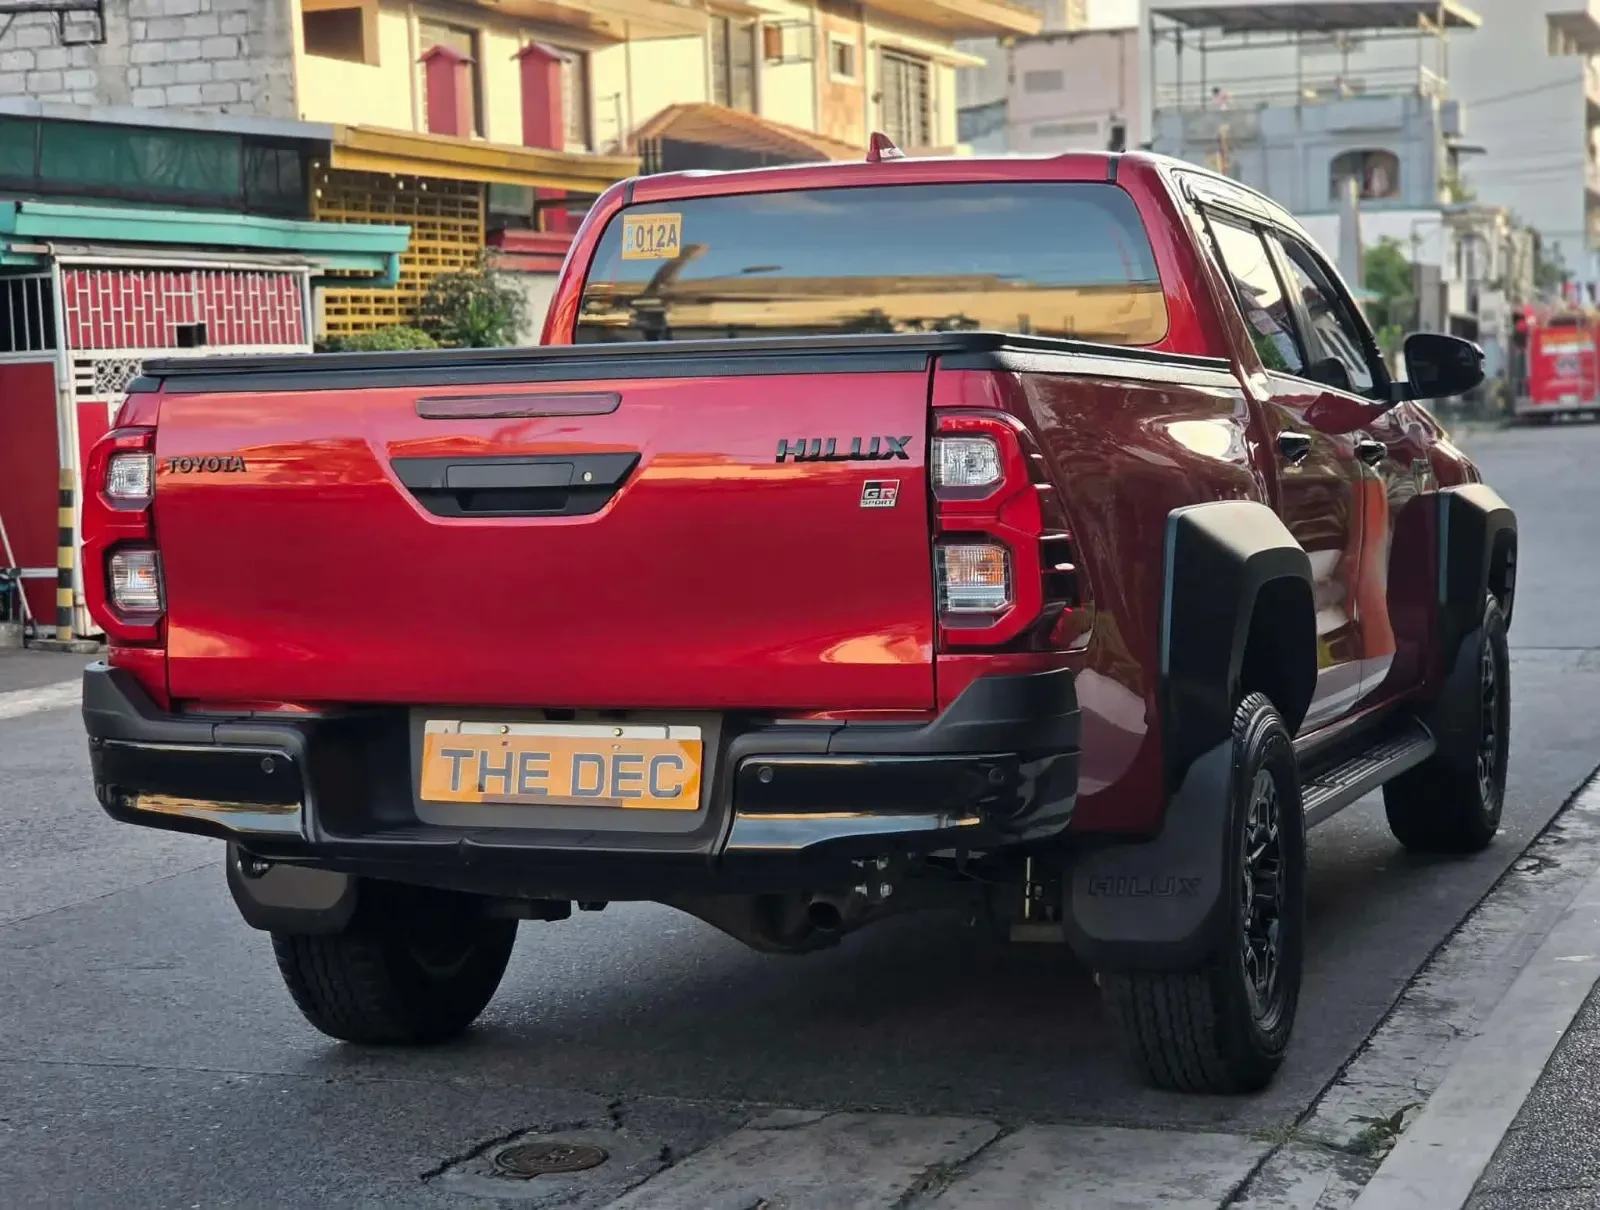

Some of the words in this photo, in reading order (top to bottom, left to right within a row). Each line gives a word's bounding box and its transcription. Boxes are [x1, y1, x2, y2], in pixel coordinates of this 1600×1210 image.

[635, 223, 677, 249] 012A
[776, 436, 912, 462] HILUX
[167, 456, 247, 473] TOYOTA
[864, 488, 896, 499] GR
[440, 748, 551, 796] THE
[569, 753, 684, 798] DEC
[1088, 876, 1202, 897] HILUX
